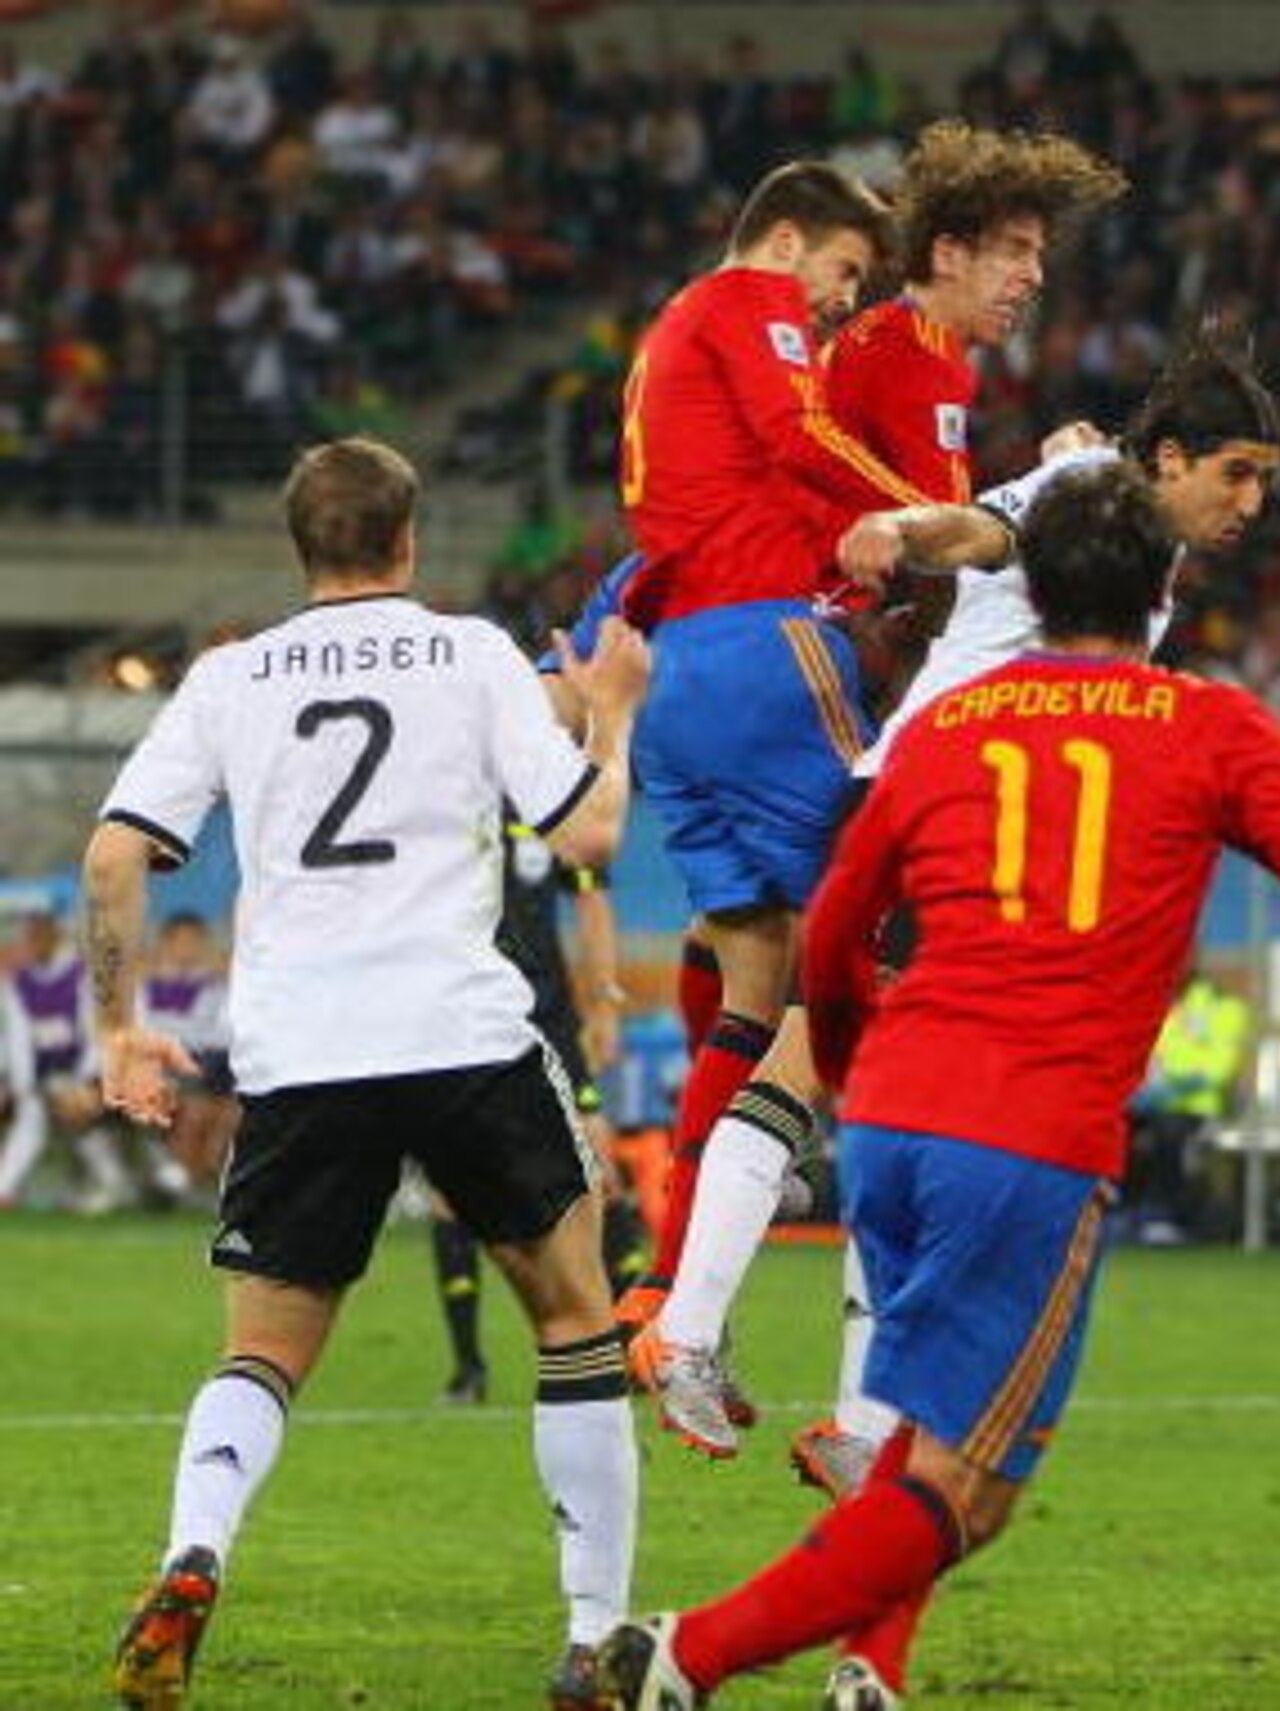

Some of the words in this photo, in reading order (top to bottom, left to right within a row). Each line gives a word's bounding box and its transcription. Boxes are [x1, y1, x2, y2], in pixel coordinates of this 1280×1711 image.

[252, 635, 455, 681] JANSEN
[934, 680, 1176, 729] CAPDEVILA
[295, 696, 396, 869] 2
[981, 740, 1110, 933] 11
